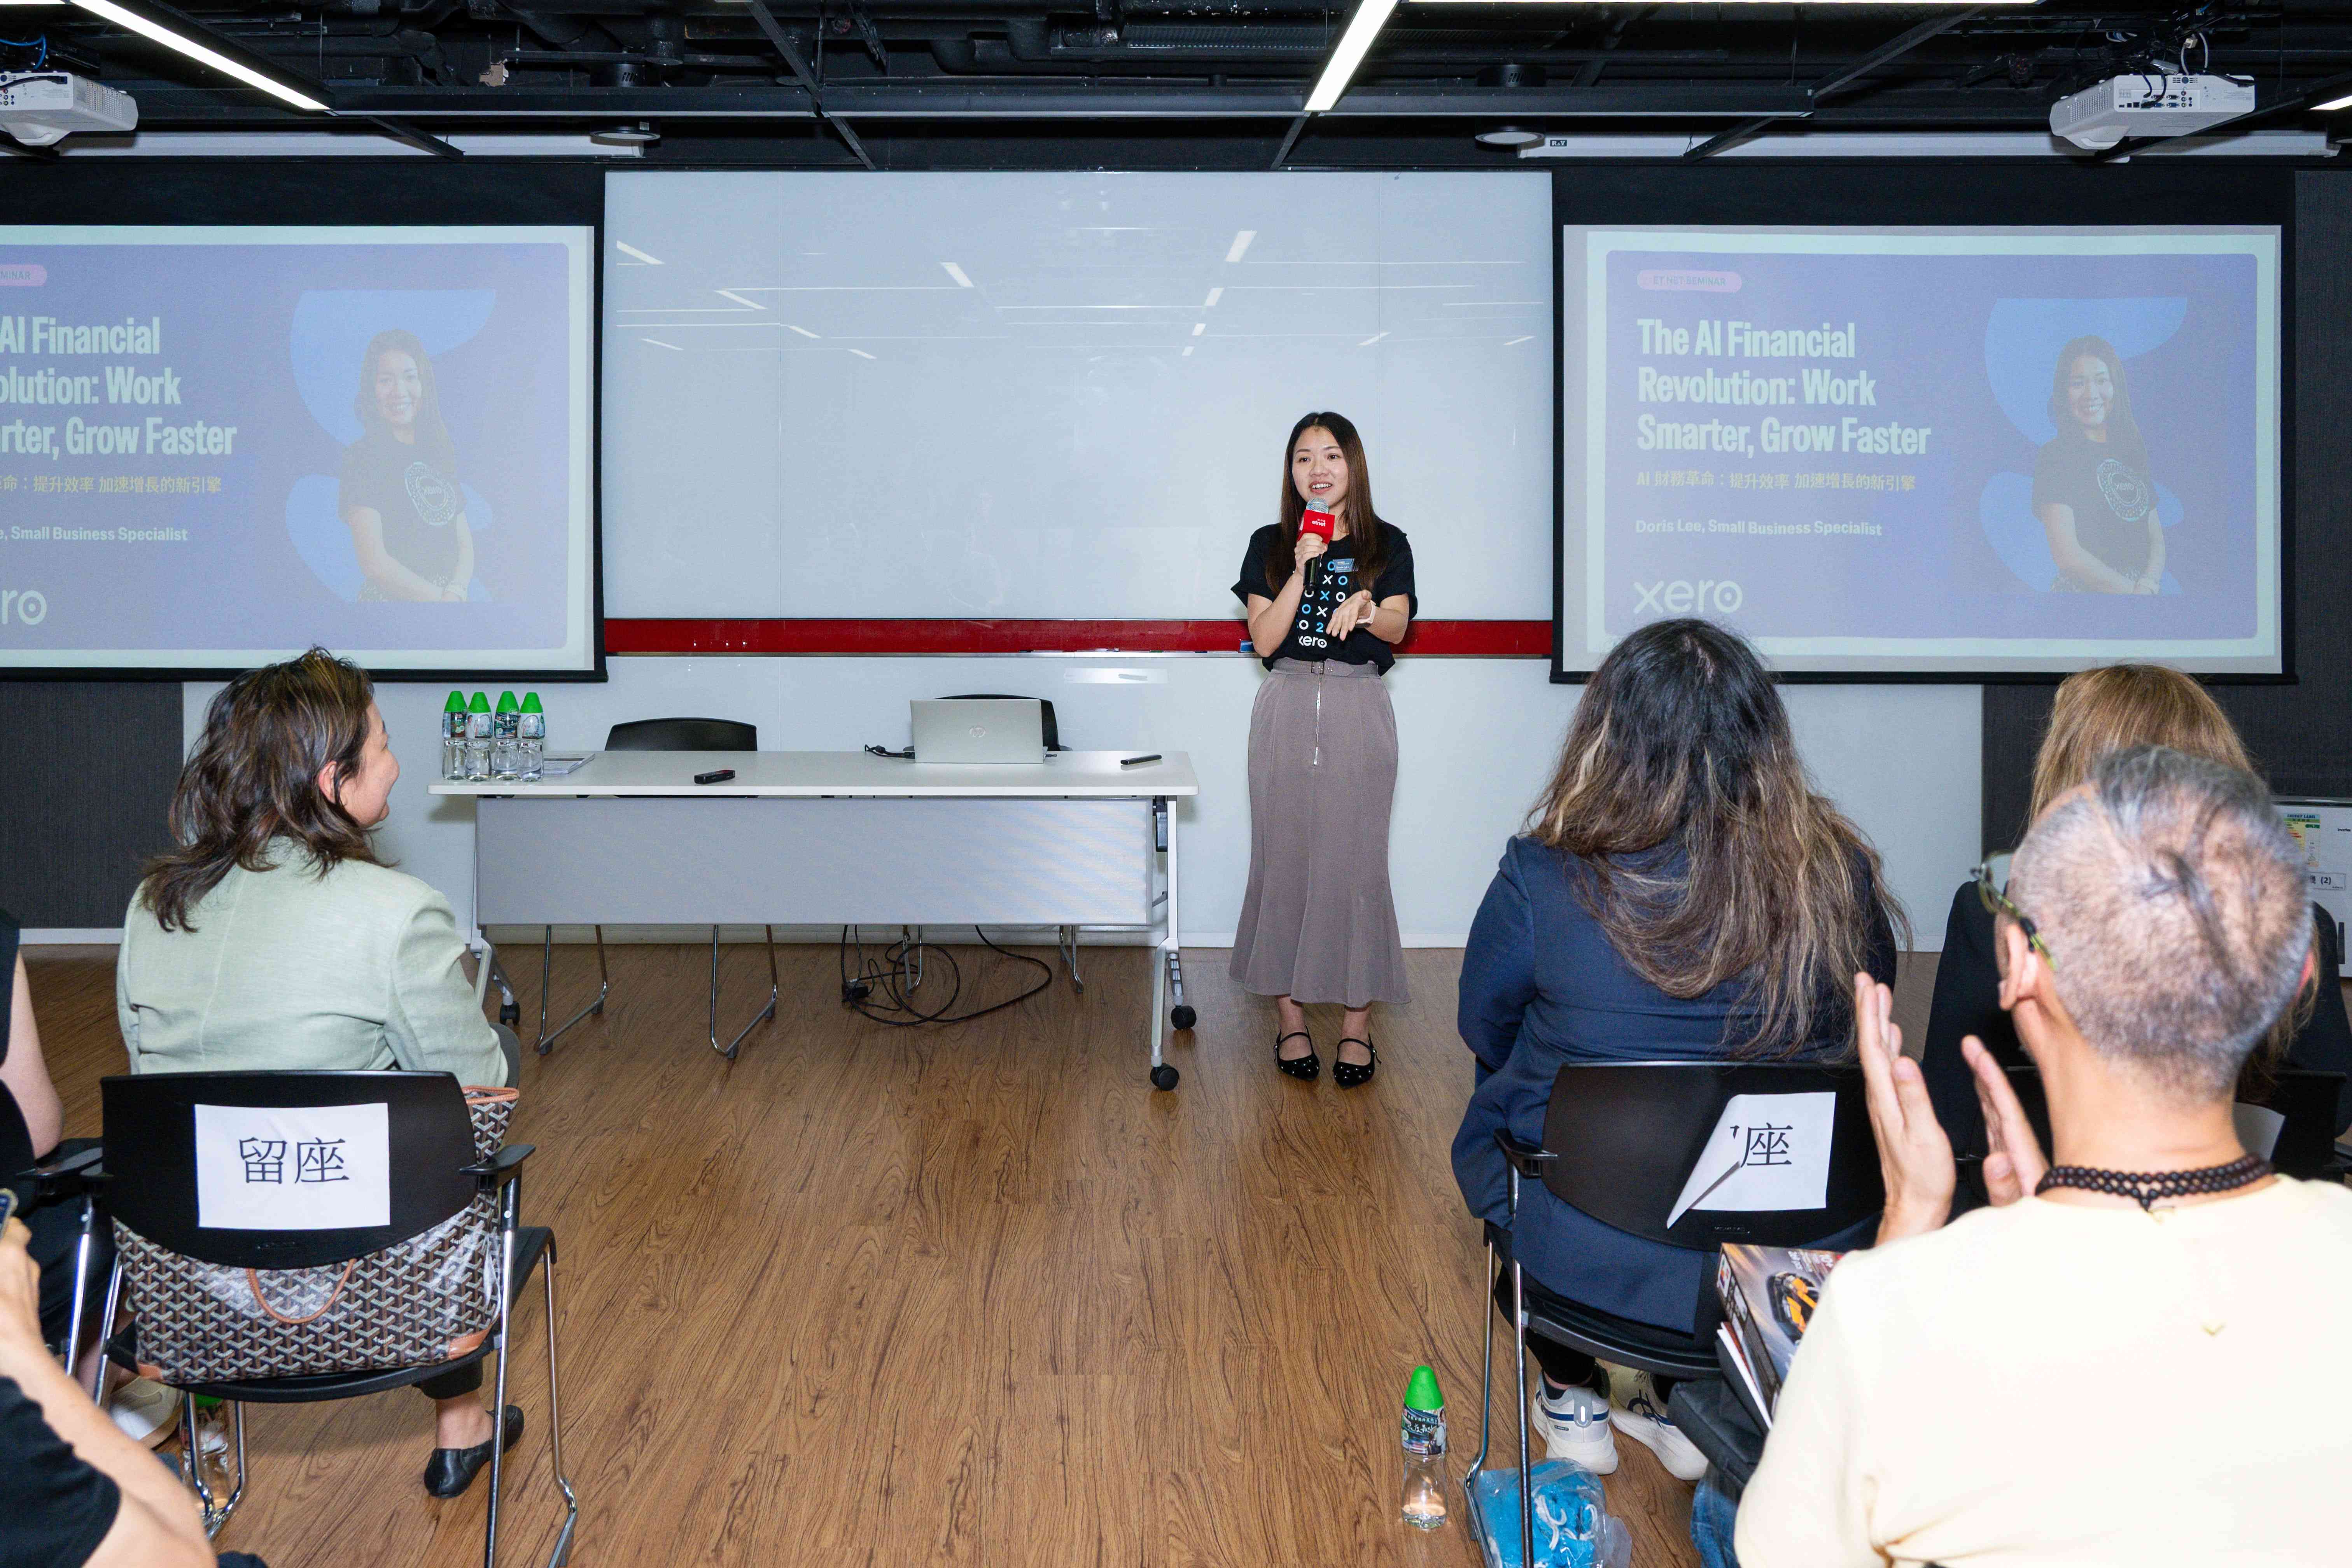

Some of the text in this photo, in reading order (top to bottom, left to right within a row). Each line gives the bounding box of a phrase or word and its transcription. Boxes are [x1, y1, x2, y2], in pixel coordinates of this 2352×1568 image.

[33, 316, 160, 354] Financial
[1637, 318, 1855, 357] The AI Financial
[105, 366, 182, 404] Work
[1638, 367, 1877, 406] Revolution: Work
[66, 416, 139, 454] Grow
[146, 417, 237, 455] Faster
[1637, 413, 1932, 458] Smarter, Grow Faster
[99, 476, 221, 494] 加速增長的新引擎
[1636, 472, 1650, 486] AI
[1795, 472, 1916, 492] 加速增長的新引擎
[11, 526, 49, 540] Small
[53, 527, 115, 541] Business
[118, 527, 188, 543] Specialist
[1636, 520, 1882, 536] Doris Lee, Small Business Specialist
[1633, 579, 1743, 614] xero
[2320, 876, 2331, 885] (2)
[239, 1136, 350, 1184] 留座
[1730, 1122, 1793, 1168] 座
